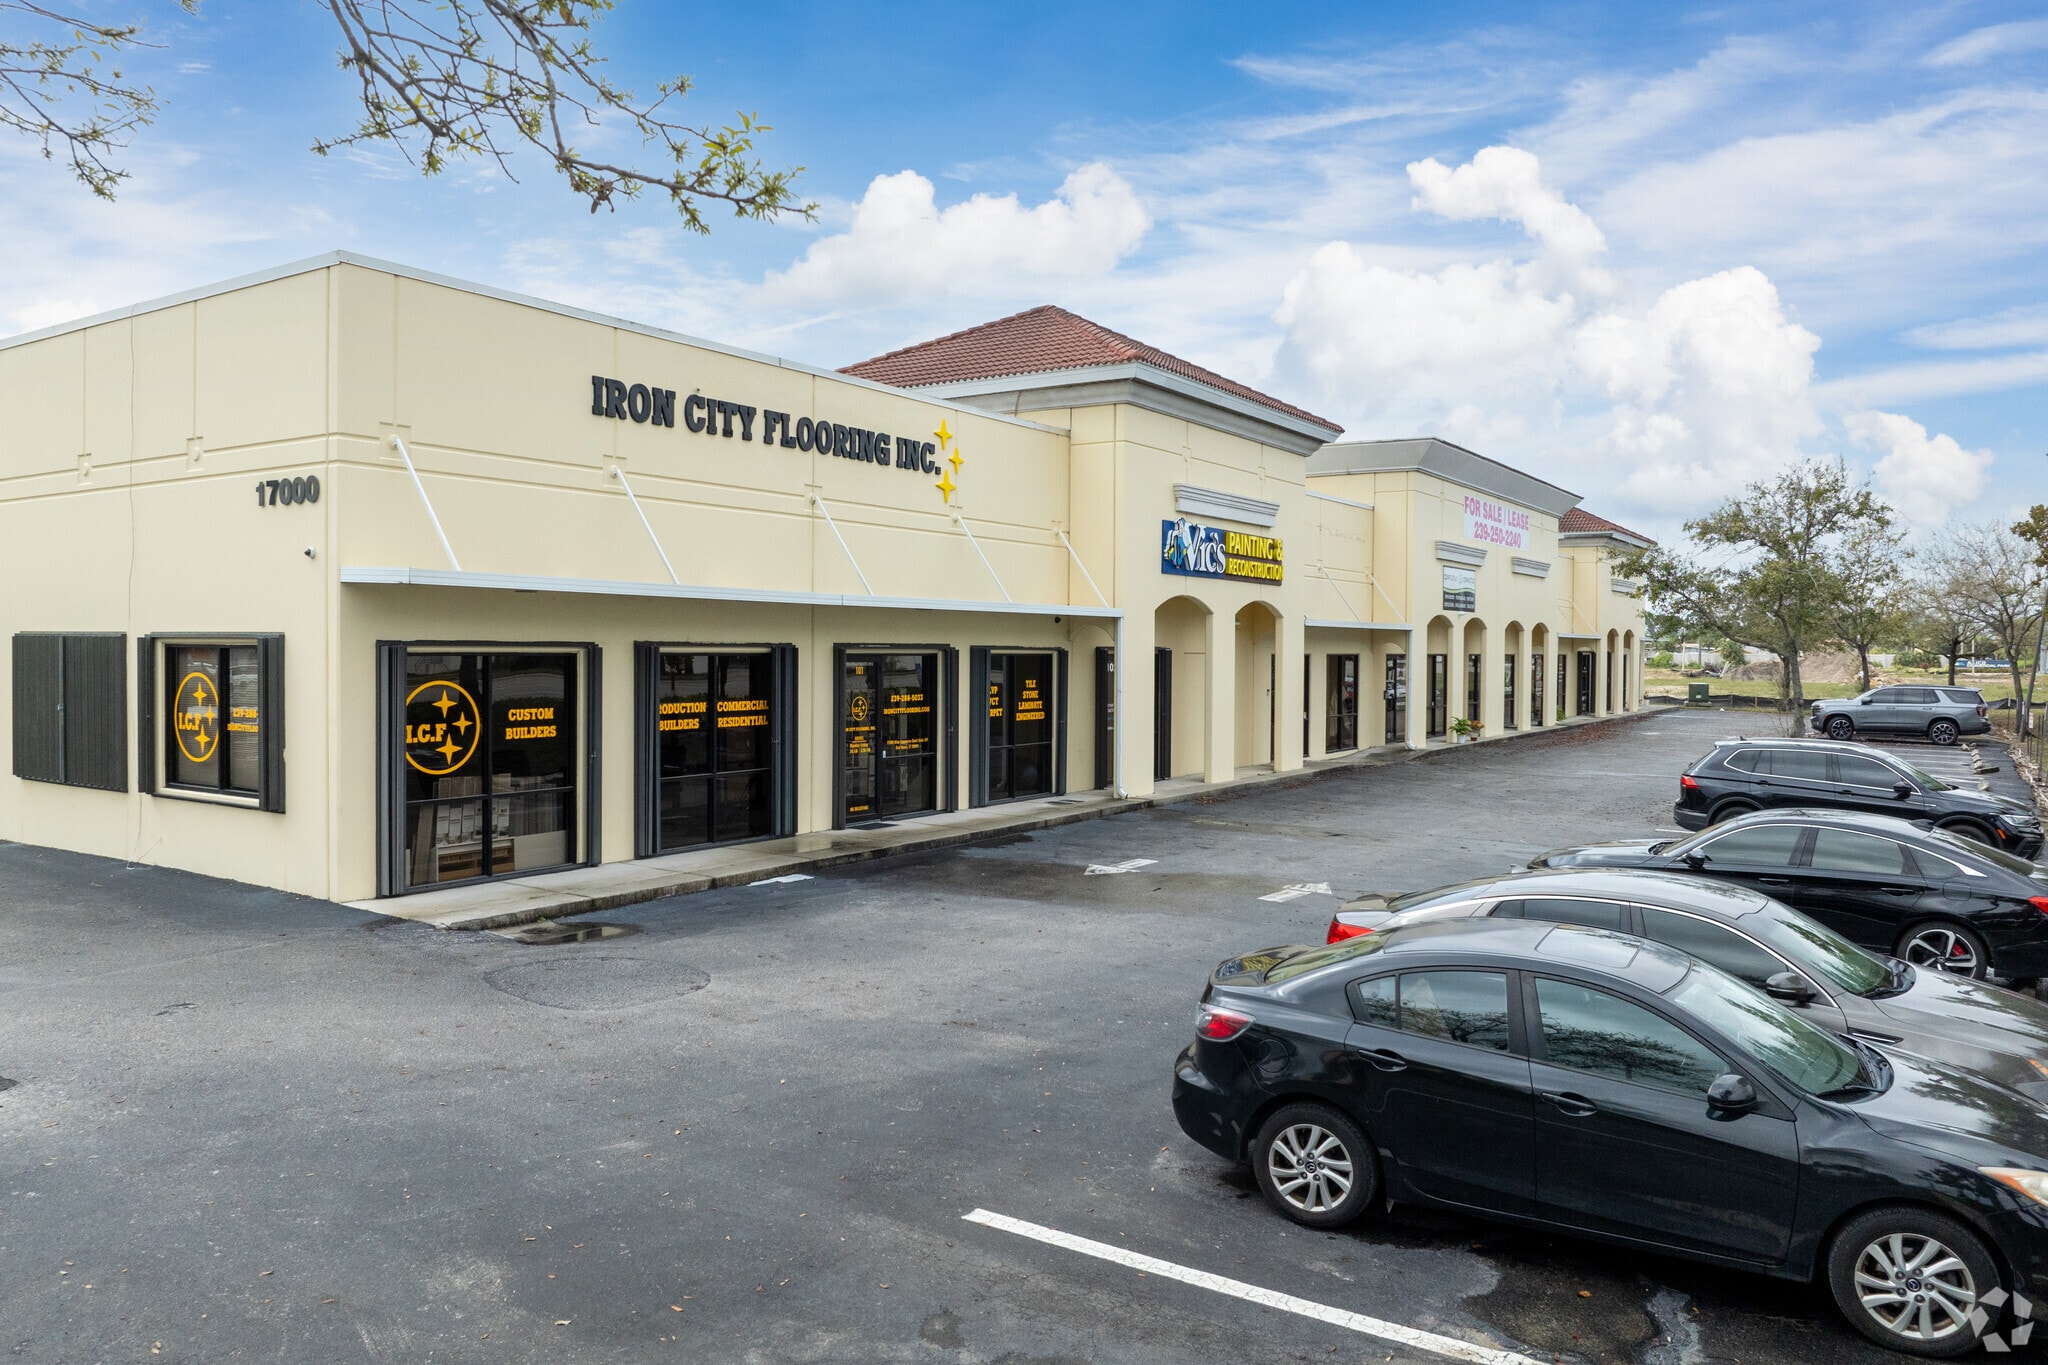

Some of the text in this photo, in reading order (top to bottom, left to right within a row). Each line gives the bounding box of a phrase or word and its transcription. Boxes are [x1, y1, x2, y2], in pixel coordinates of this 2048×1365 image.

[592, 375, 942, 475] IRON CITY FLOORING INC.
[256, 475, 320, 506] 17000
[1464, 496, 1480, 517] FOR
[1483, 502, 1502, 523] SALE
[1508, 510, 1529, 531] LEASE
[1474, 521, 1521, 549] 239-250-2240
[1227, 531, 1284, 562] PAINTING &
[1227, 558, 1284, 581] RECONSTRUCTION
[990, 685, 998, 694] VP
[1025, 679, 1036, 688] TILE
[1023, 690, 1039, 699] STONE
[659, 702, 707, 715] RODUCTION
[717, 700, 769, 712] COMMERCIAL
[508, 707, 554, 721] CUSTOM
[659, 719, 700, 731] BUILDERS
[718, 716, 768, 728] RESIDENTIAL
[406, 723, 447, 744] I.C.F
[505, 725, 557, 740] BUILDERS
